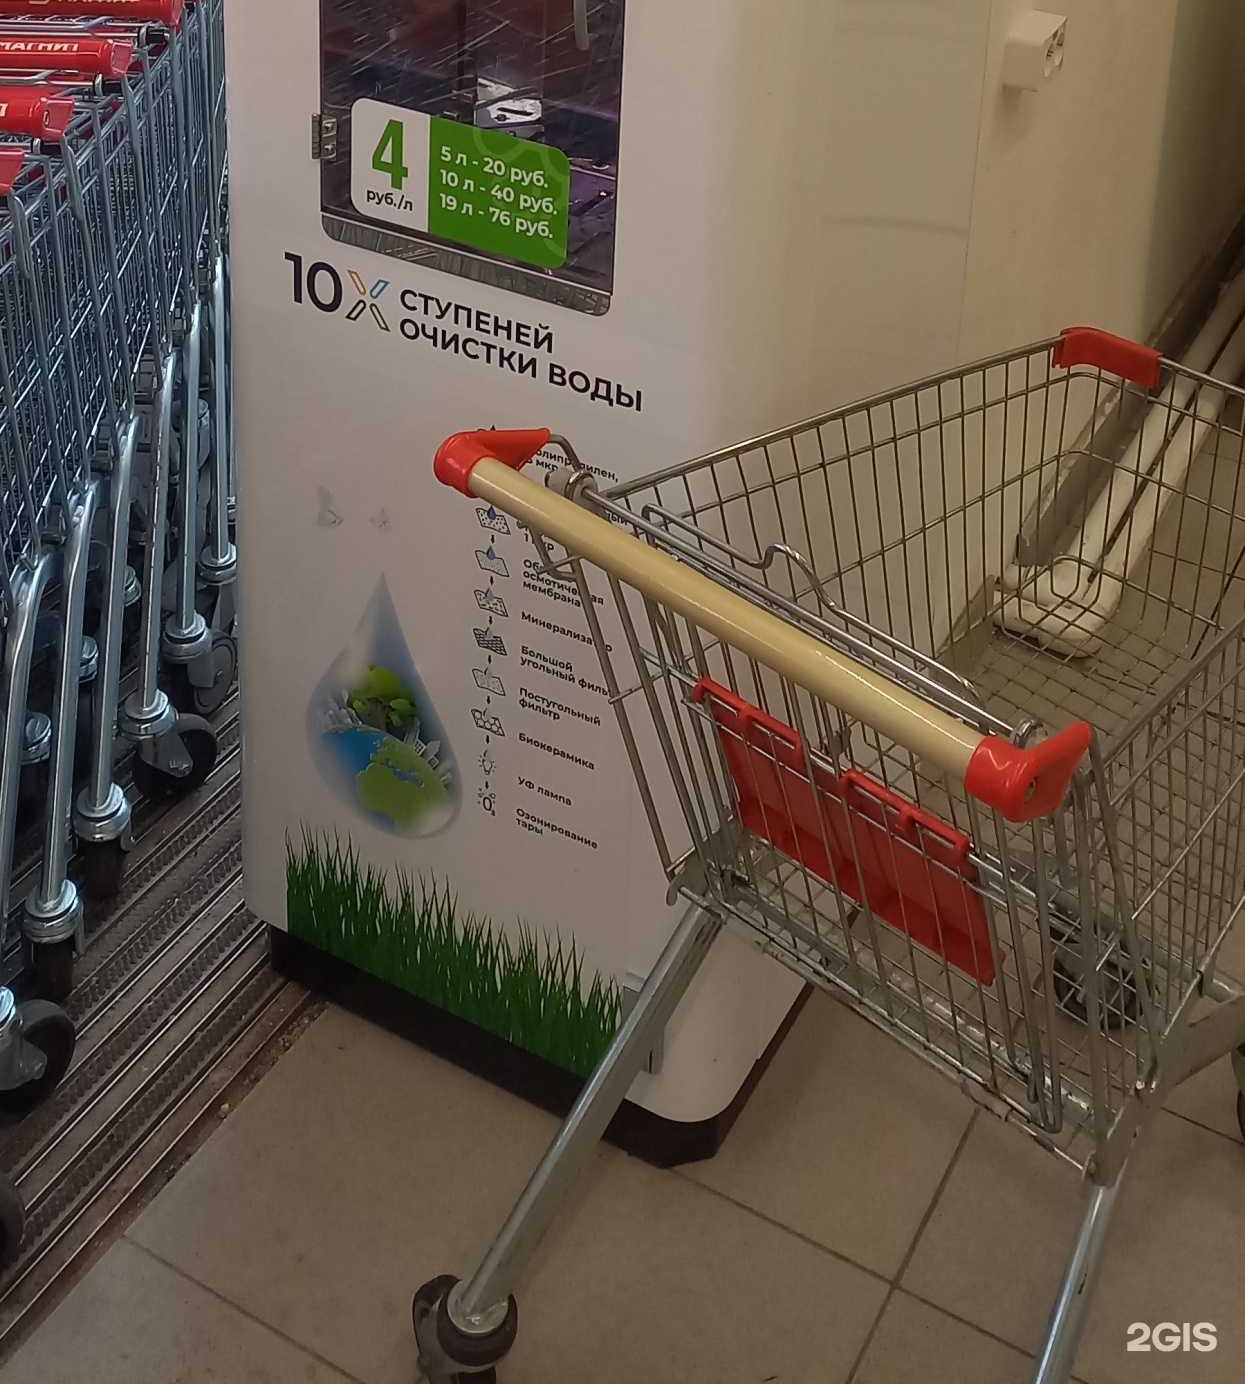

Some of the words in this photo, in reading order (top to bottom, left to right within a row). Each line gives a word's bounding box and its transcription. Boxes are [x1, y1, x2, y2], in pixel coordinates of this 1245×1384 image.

[371, 119, 408, 191] 4
[440, 146, 451, 161] 5
[456, 154, 467, 166] л
[483, 157, 505, 176] 20
[510, 167, 548, 188] руб.
[366, 187, 412, 212] руб./л
[440, 169, 458, 187] 10
[463, 179, 474, 192] л
[491, 185, 514, 203] 40
[519, 194, 557, 215] руб.
[440, 193, 457, 211] 19
[461, 203, 473, 215] л
[489, 208, 510, 226] 76
[515, 218, 553, 238] руб.
[399, 289, 553, 354] СТУПЕНЕЙ
[399, 318, 537, 378] ОЧИСТКИ
[549, 363, 642, 412] ВОДЫ
[523, 571, 604, 605] осмотичеая
[523, 581, 581, 608] мембрана
[521, 611, 612, 652] Минерализар
[520, 656, 575, 686] угольный
[578, 677, 610, 697] филь
[521, 645, 573, 673] Большой
[519, 687, 601, 727] Постугольный
[519, 698, 560, 721] фильтр
[518, 732, 595, 770] Биокерамика
[518, 776, 534, 791] УФ
[537, 785, 572, 806] лампа
[516, 818, 544, 836] тары
[516, 808, 598, 850] Озонирование
